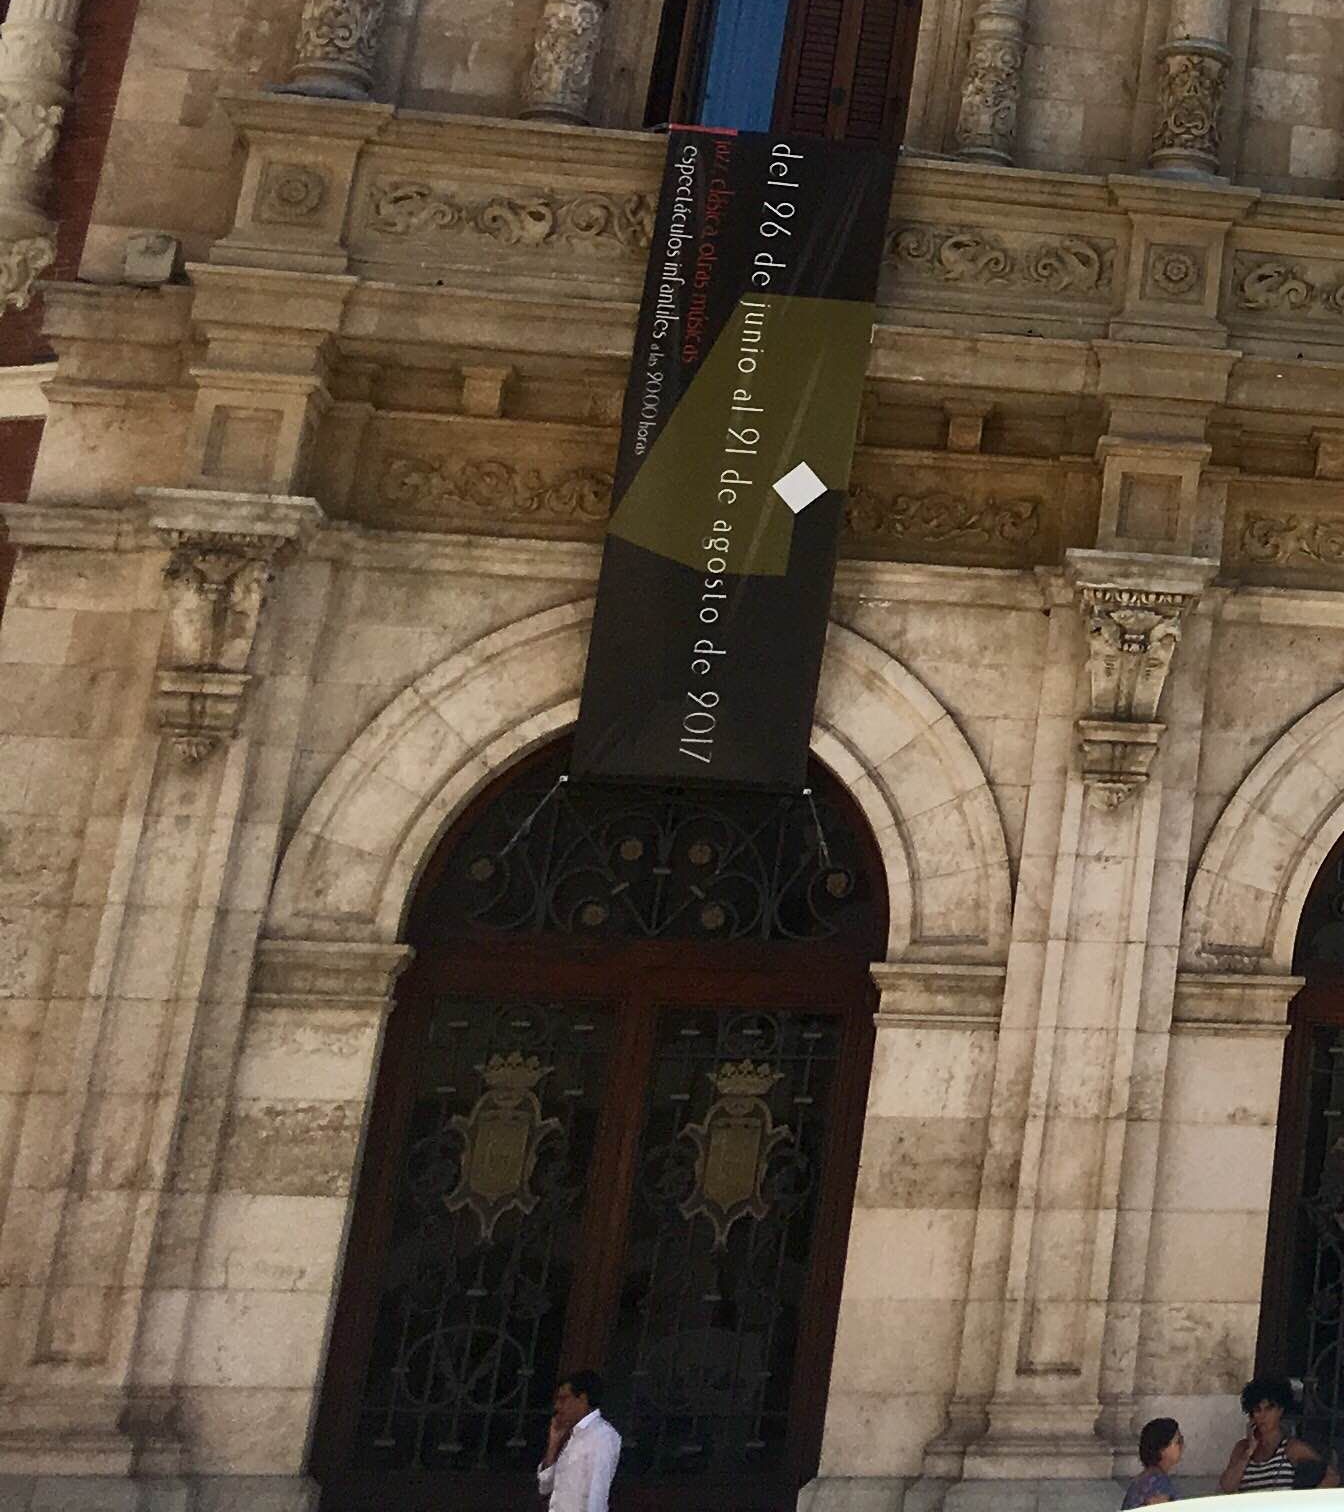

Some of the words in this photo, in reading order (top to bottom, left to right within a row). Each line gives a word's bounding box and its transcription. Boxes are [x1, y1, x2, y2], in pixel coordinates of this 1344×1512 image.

[768, 143, 804, 188] del
[666, 145, 698, 257] espectáculos
[694, 243, 718, 289] otras
[751, 252, 787, 287] de
[652, 262, 686, 339] infantiles
[682, 294, 709, 364] músicas
[737, 301, 771, 374] junio
[648, 352, 665, 367] las
[731, 388, 764, 412] al
[635, 421, 656, 456] horas
[717, 469, 753, 505] de
[699, 520, 733, 624] agosto
[691, 640, 727, 675] de
